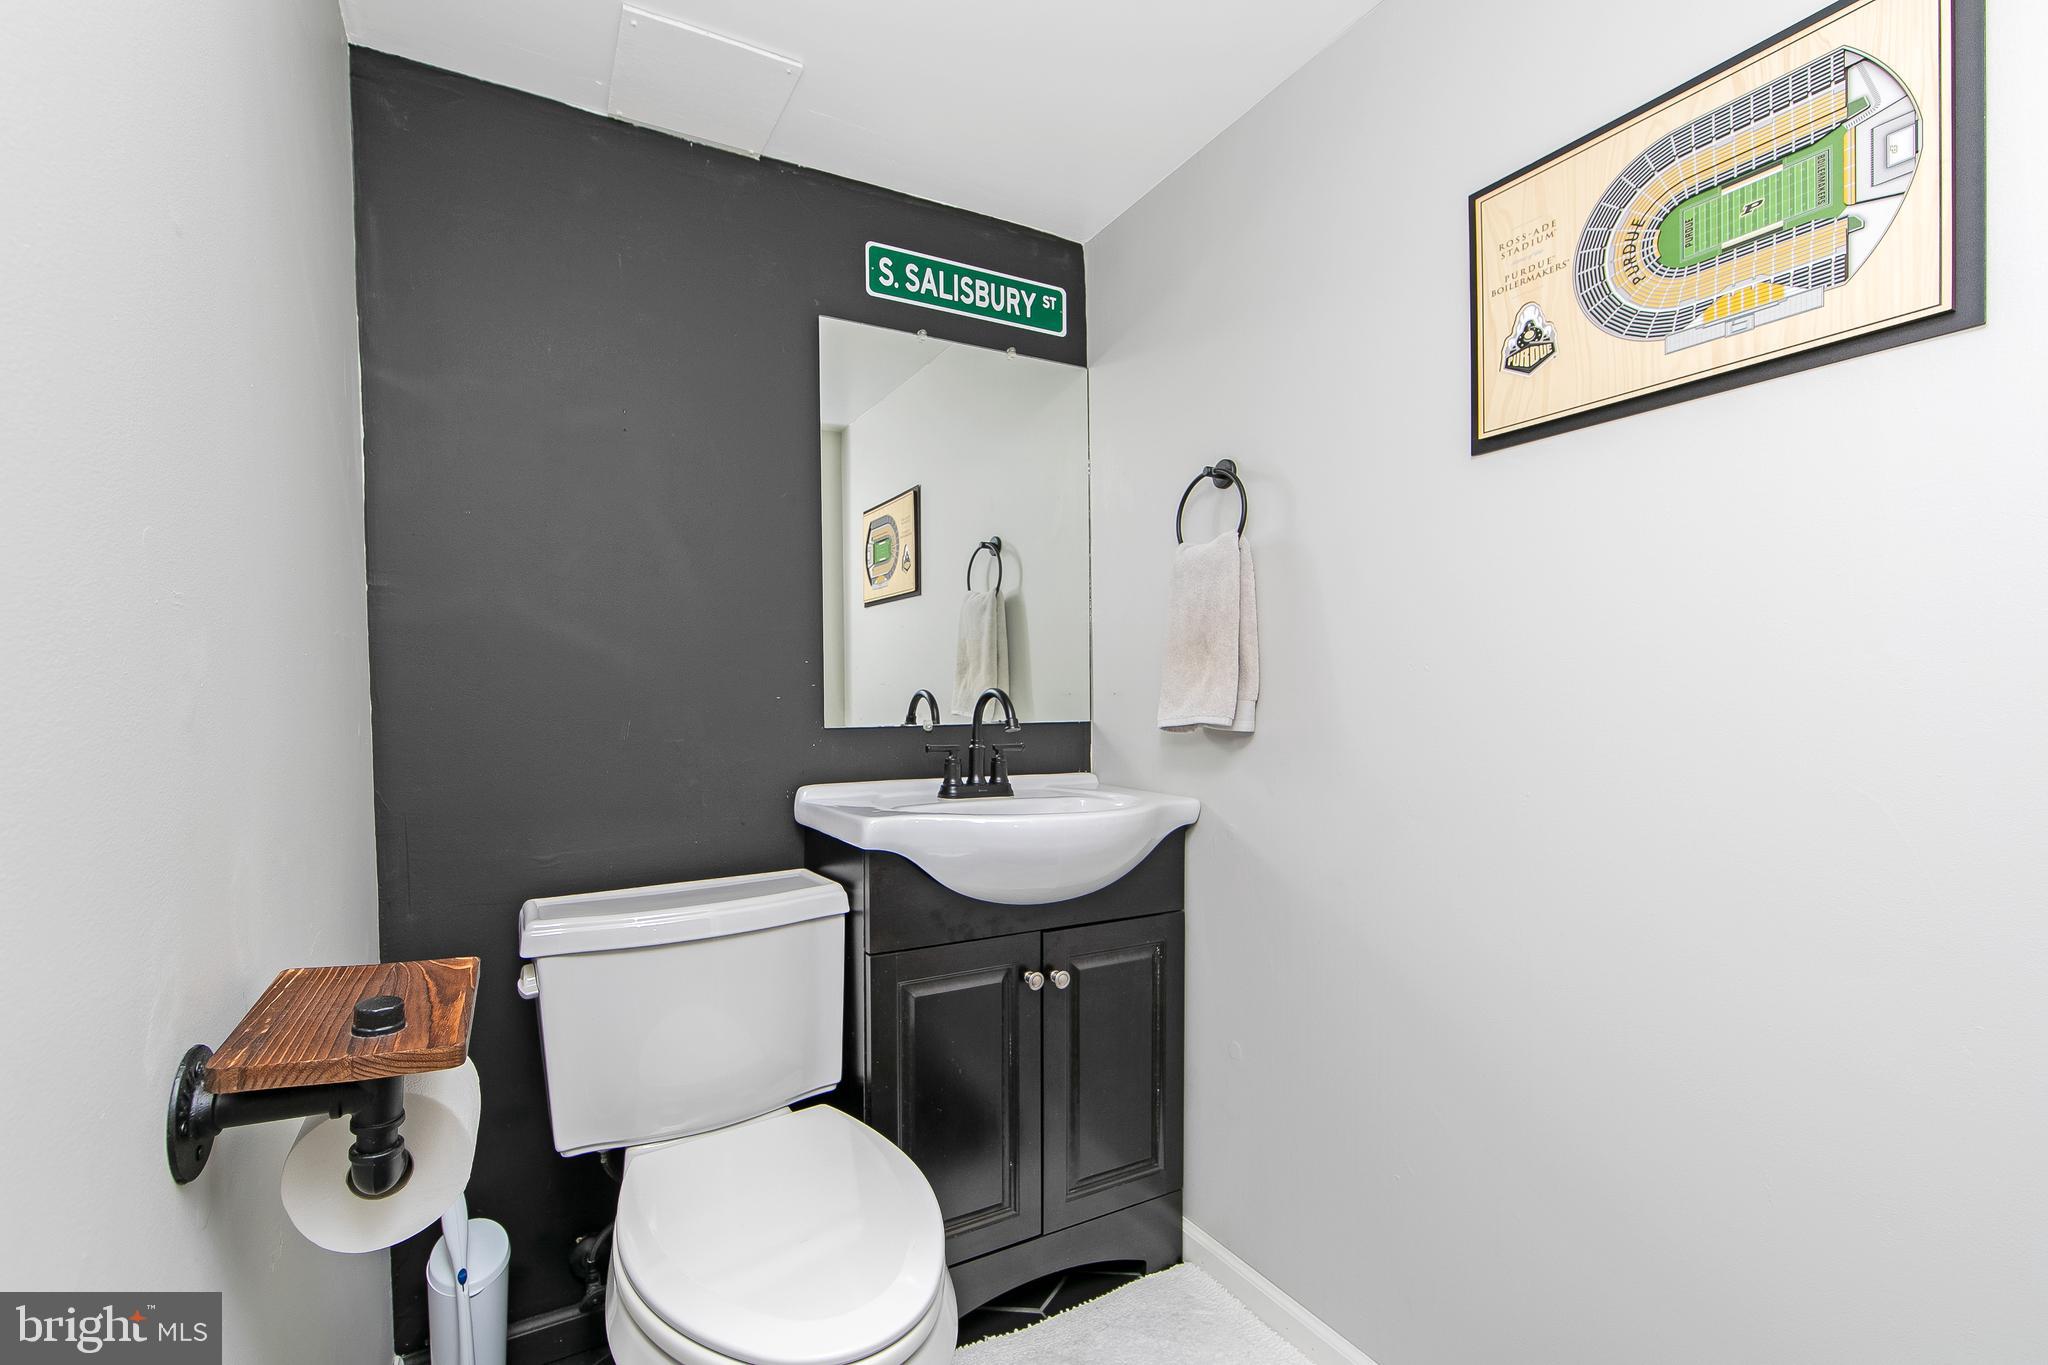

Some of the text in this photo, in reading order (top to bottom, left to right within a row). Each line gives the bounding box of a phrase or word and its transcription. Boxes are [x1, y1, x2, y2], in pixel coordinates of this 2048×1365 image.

[1816, 153, 1826, 206] BOILERMAKERS
[1499, 218, 1557, 252] ROSS-ADE
[1623, 215, 1646, 286] PURDUE
[1684, 217, 1694, 248] PURDUE
[878, 257, 1057, 318] S. SALISBURY ST
[1507, 343, 1553, 368] PURDUE
